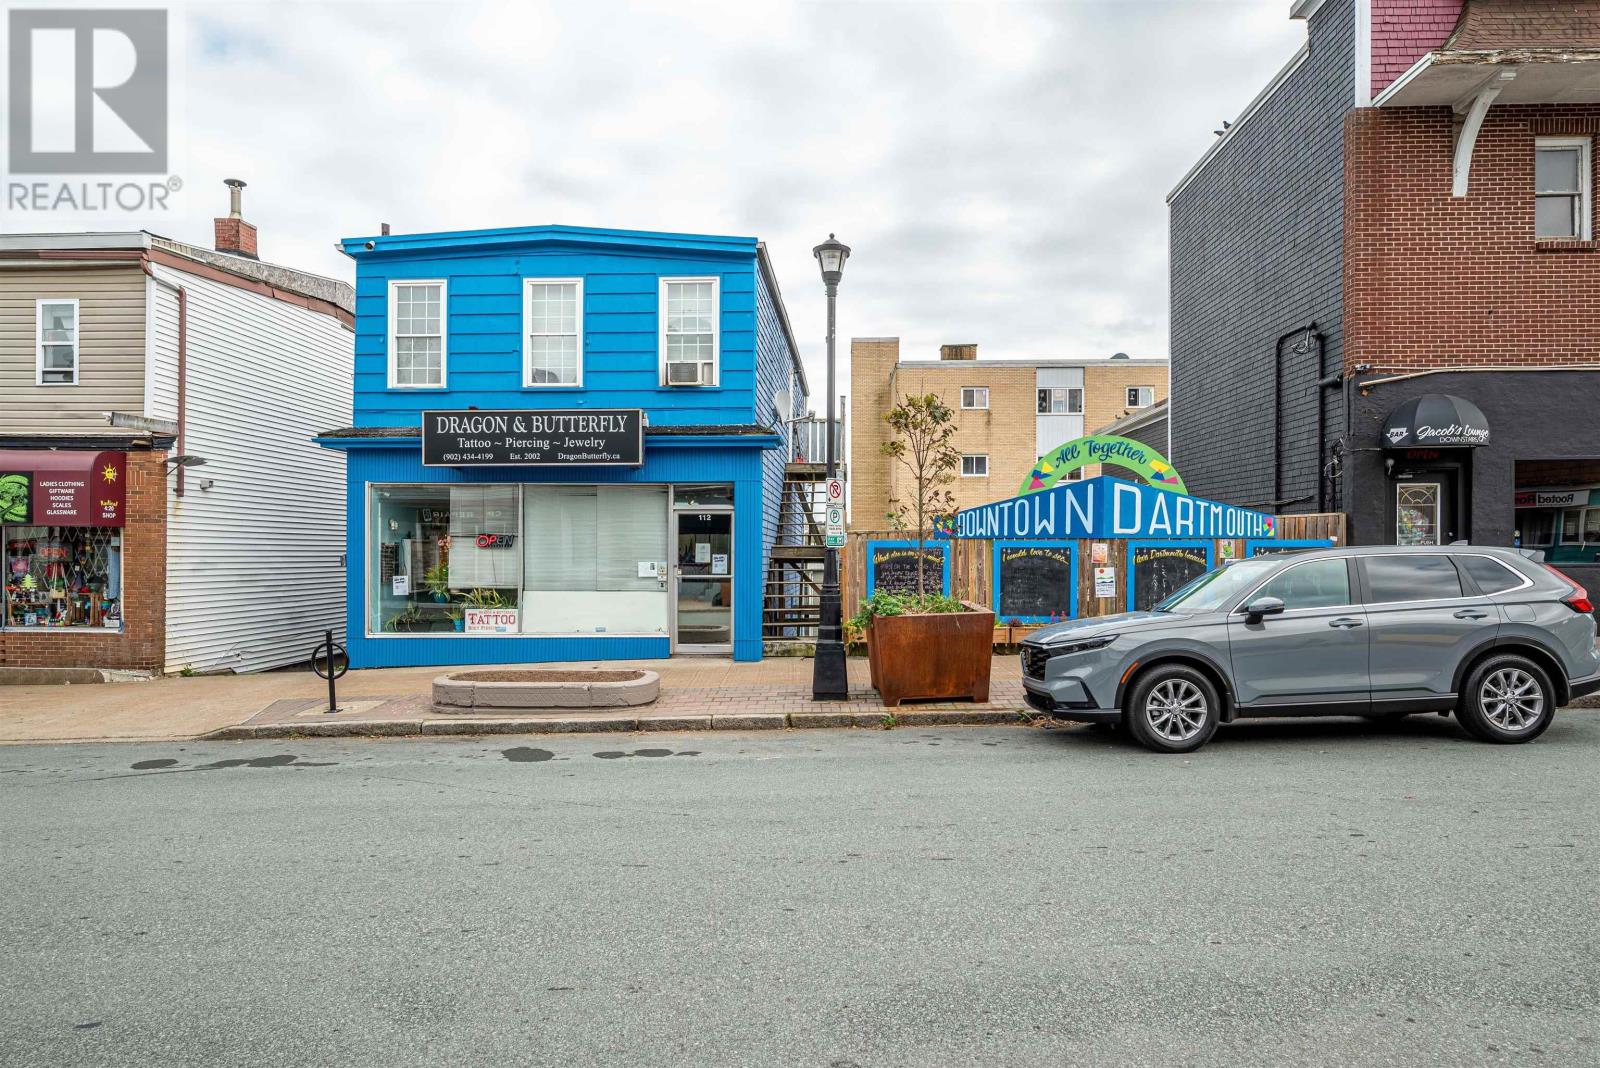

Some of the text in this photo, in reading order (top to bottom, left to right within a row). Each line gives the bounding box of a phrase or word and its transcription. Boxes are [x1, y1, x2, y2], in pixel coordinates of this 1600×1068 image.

[436, 415, 627, 434] DRAGON & BUTTERFLY
[1416, 424, 1489, 442] Jacob's Lounge
[457, 438, 491, 448] Tattoo
[505, 437, 550, 450] Piercing
[563, 437, 606, 449] Jewelry
[443, 453, 461, 461] (902)
[557, 452, 620, 461] DragonButterfly.ca
[1055, 440, 1147, 469] All Together
[958, 482, 1263, 537] DOWNTOWN DARTMOUTH
[476, 534, 514, 547] OPEN
[1006, 549, 1028, 560] would
[1029, 548, 1043, 556] love
[1150, 549, 1184, 560] Dartmouth
[468, 613, 516, 625] TATTOO
